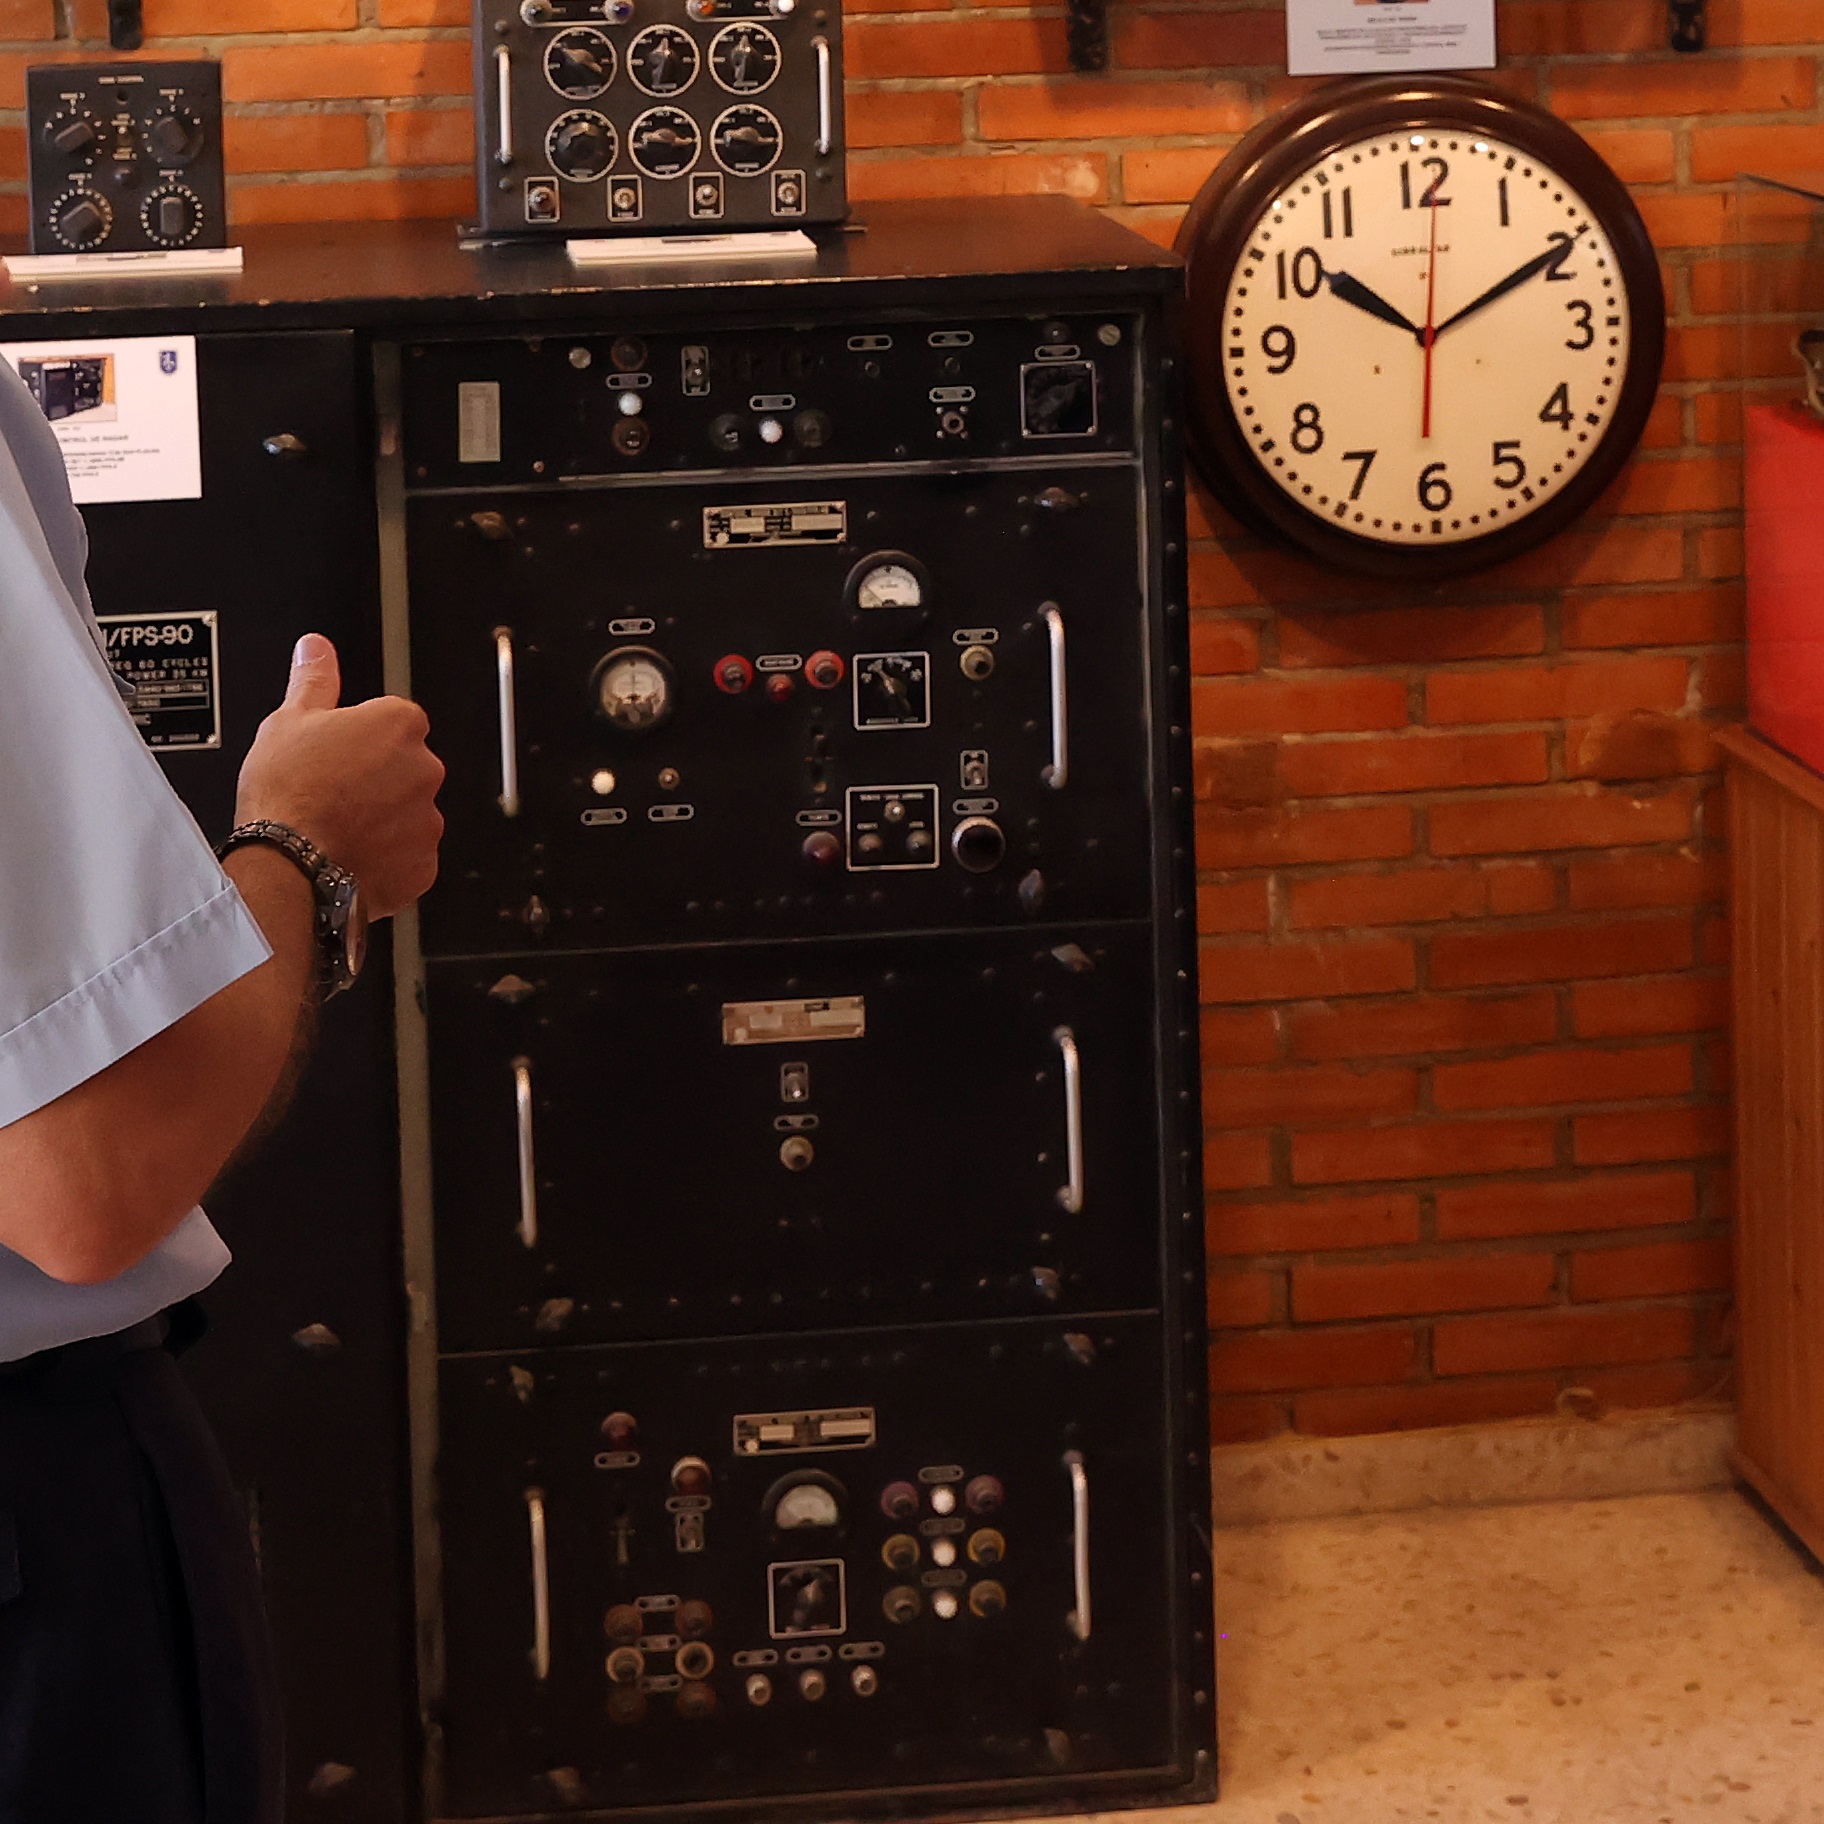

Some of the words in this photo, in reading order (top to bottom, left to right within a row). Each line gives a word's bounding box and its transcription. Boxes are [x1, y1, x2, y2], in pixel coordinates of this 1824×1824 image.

[1400, 157, 1452, 210] 12
[1499, 177, 1510, 227] 1
[1323, 185, 1353, 239] 11
[1277, 246, 1323, 300] 10
[1543, 231, 1577, 282] 2
[1262, 325, 1297, 375] 9
[1566, 301, 1595, 351] 3
[1290, 403, 1325, 455] 8
[1538, 383, 1575, 432] 4
[1342, 450, 1378, 501] 7
[1419, 463, 1453, 513] 6
[1492, 441, 1528, 491] 5
